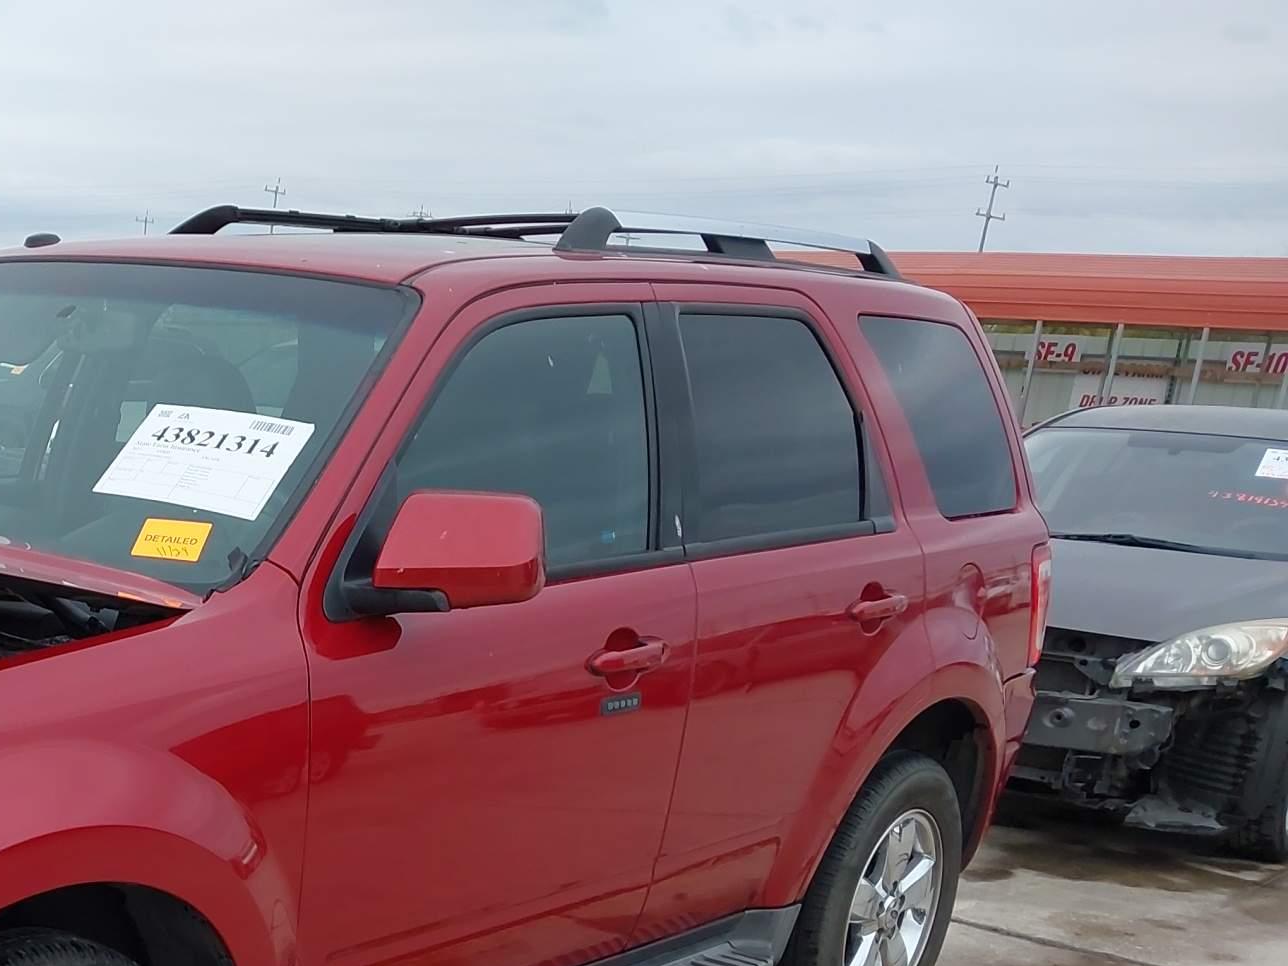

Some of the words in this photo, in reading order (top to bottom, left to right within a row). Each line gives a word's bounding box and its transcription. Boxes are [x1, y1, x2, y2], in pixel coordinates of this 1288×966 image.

[1035, 341, 1077, 361] SF-9
[1228, 350, 1288, 374] SF-10
[152, 425, 280, 458] 43821314
[144, 534, 198, 546] DETAILED
